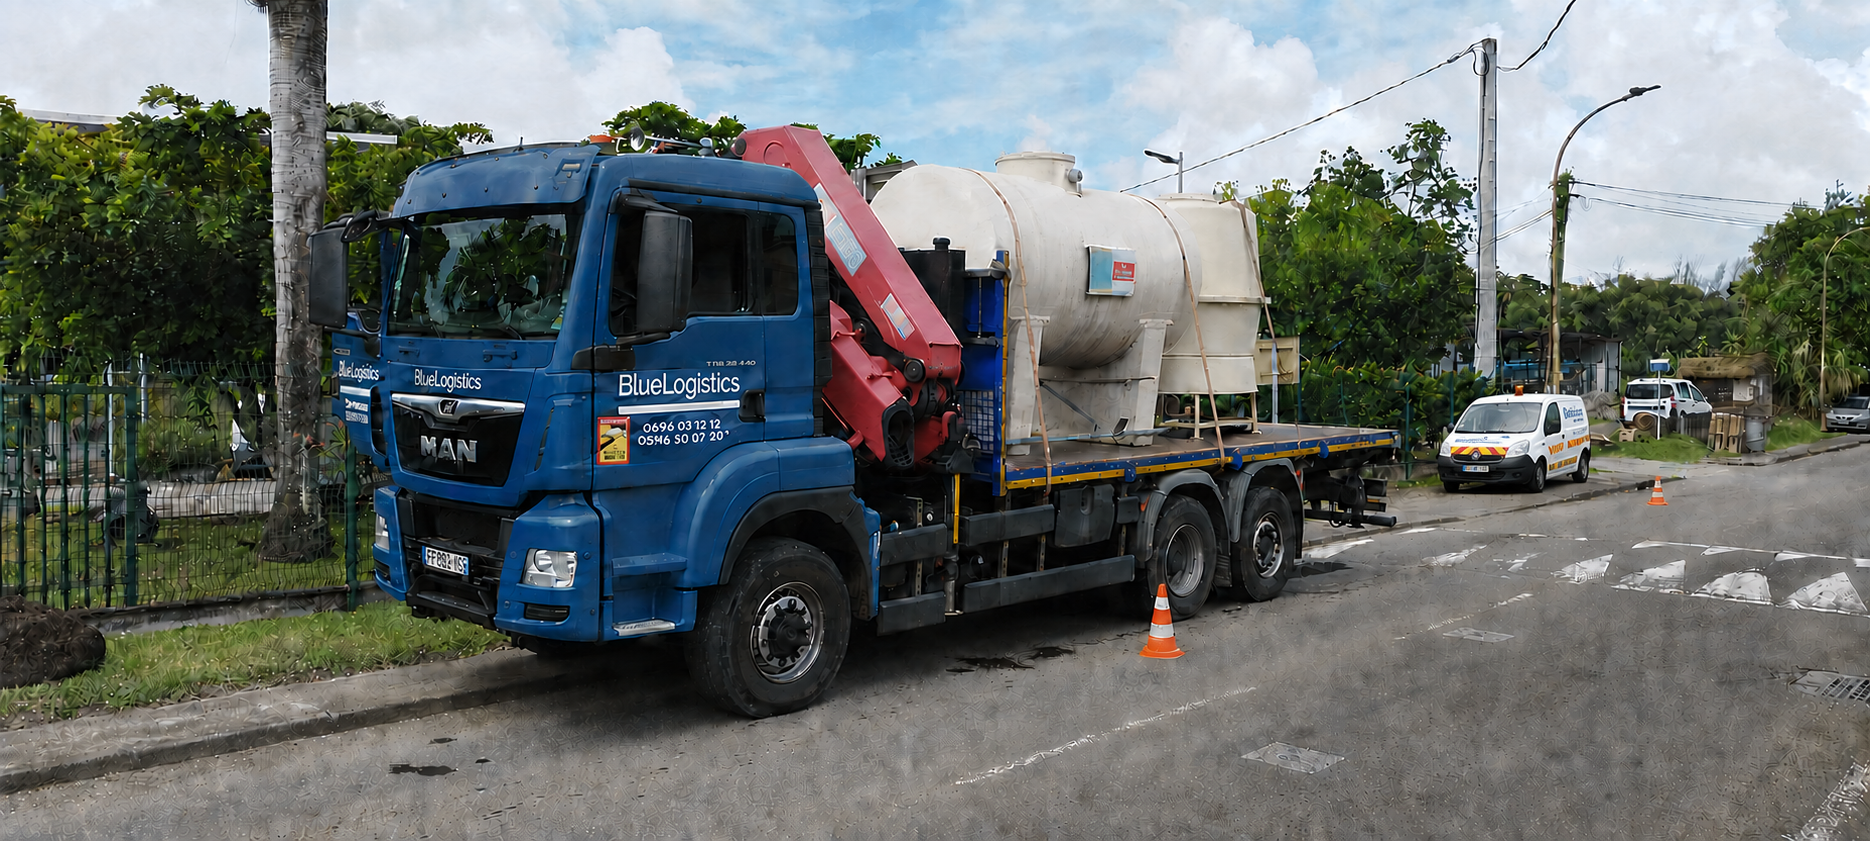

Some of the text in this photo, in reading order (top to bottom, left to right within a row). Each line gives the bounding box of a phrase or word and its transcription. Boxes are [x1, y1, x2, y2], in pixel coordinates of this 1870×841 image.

[338, 360, 380, 383] BlueLogistics
[414, 368, 482, 393] BlueLogistics
[618, 372, 741, 400] BlueLogistics
[642, 418, 721, 433] 0696 03 12 12
[691, 432, 706, 443] 07
[420, 435, 478, 463] MAN
